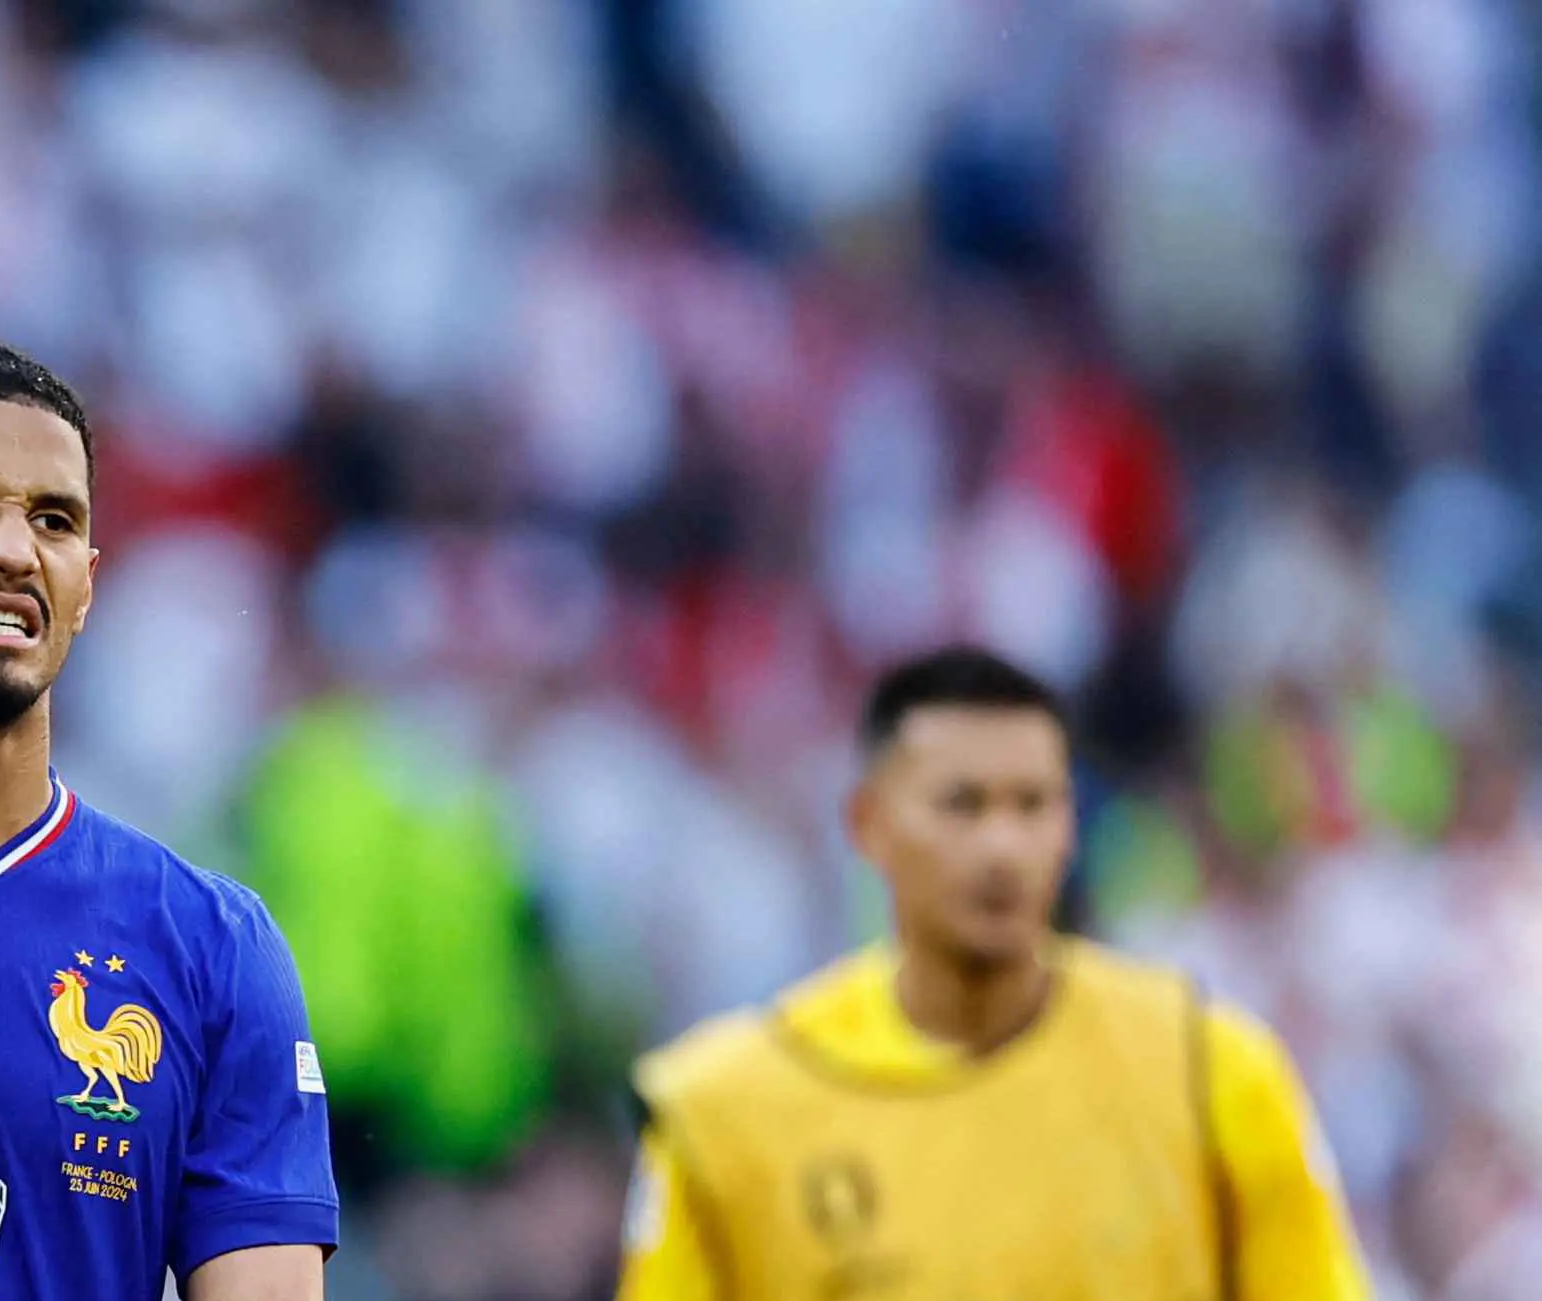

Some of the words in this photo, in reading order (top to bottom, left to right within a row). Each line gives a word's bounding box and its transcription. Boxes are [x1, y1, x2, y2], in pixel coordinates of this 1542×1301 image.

[61, 1161, 94, 1180] FRANCE
[69, 1177, 83, 1192] 25
[100, 1184, 128, 1202] 2024
